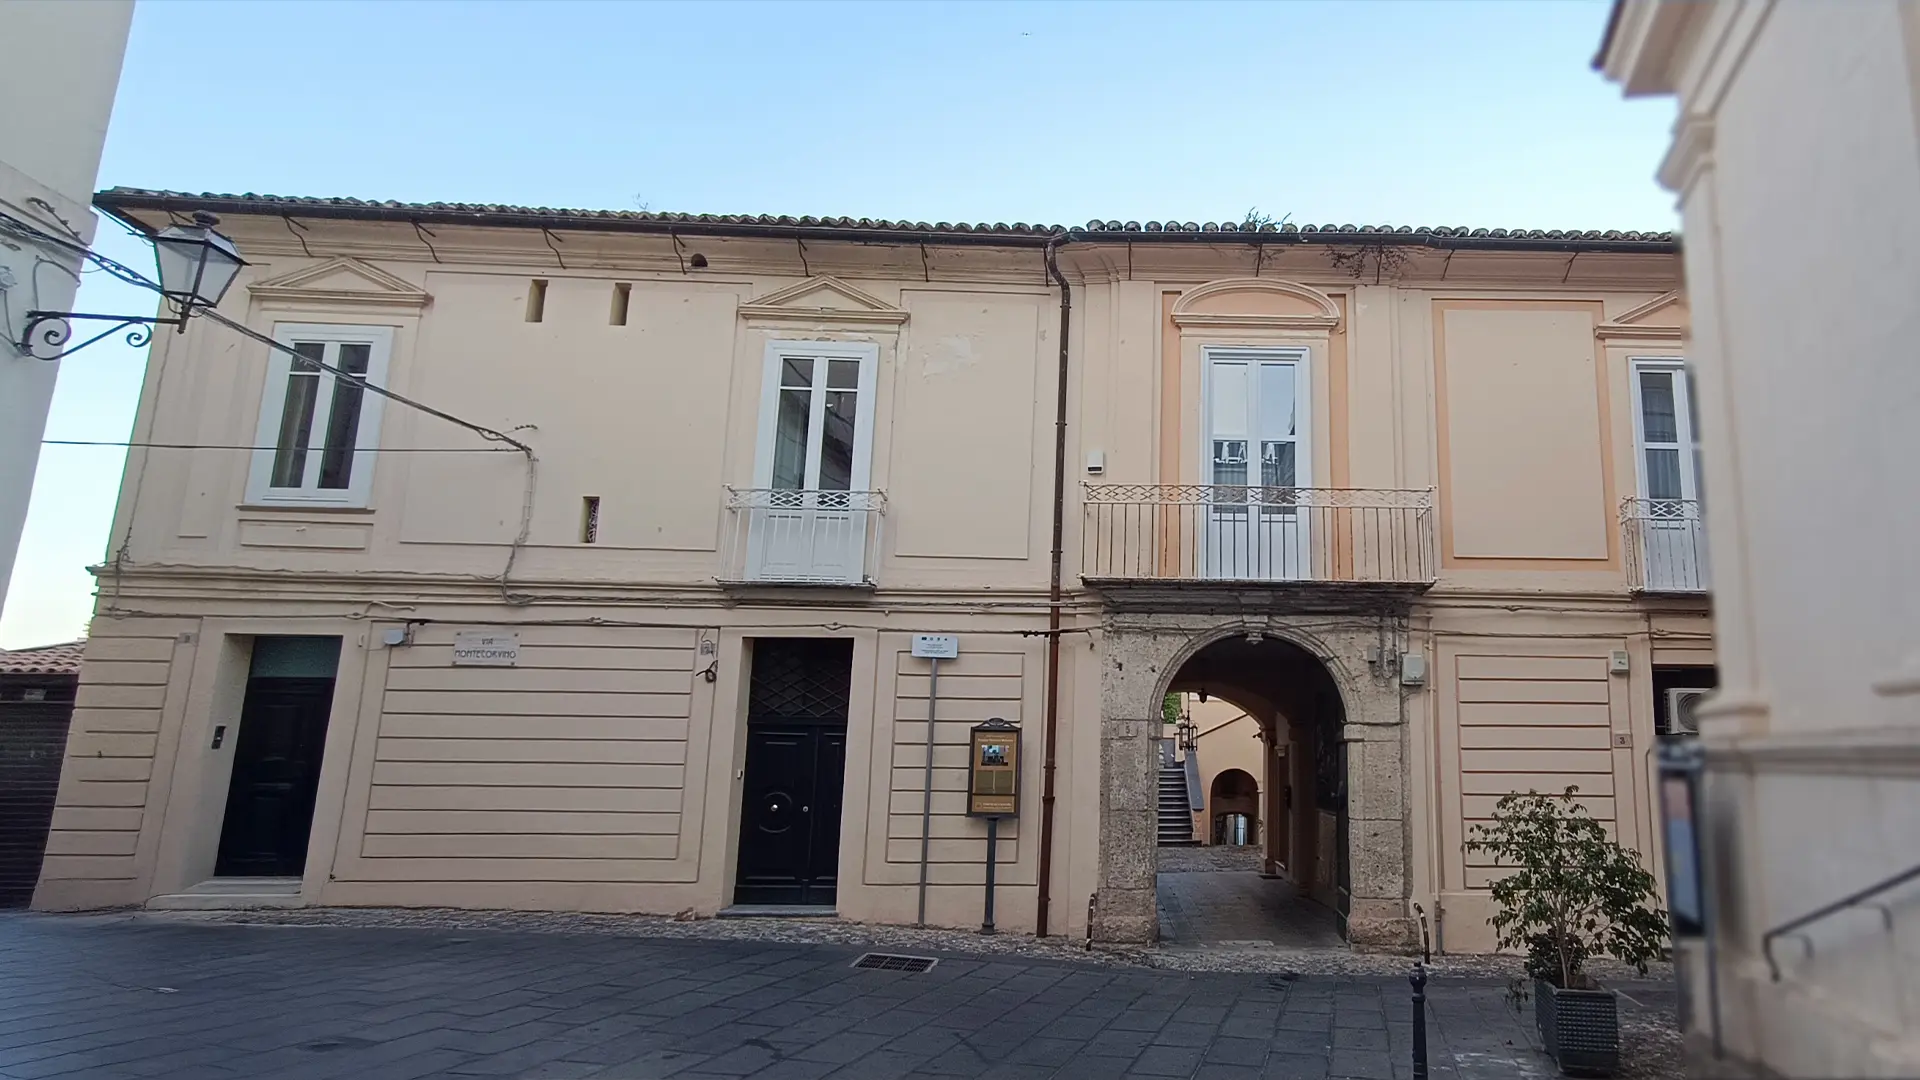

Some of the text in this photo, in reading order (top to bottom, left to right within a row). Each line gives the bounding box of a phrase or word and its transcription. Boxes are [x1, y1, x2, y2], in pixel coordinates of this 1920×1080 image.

[481, 638, 494, 646] VIA
[454, 649, 517, 659] MONTECORVINO
[1619, 736, 1626, 745] 3
